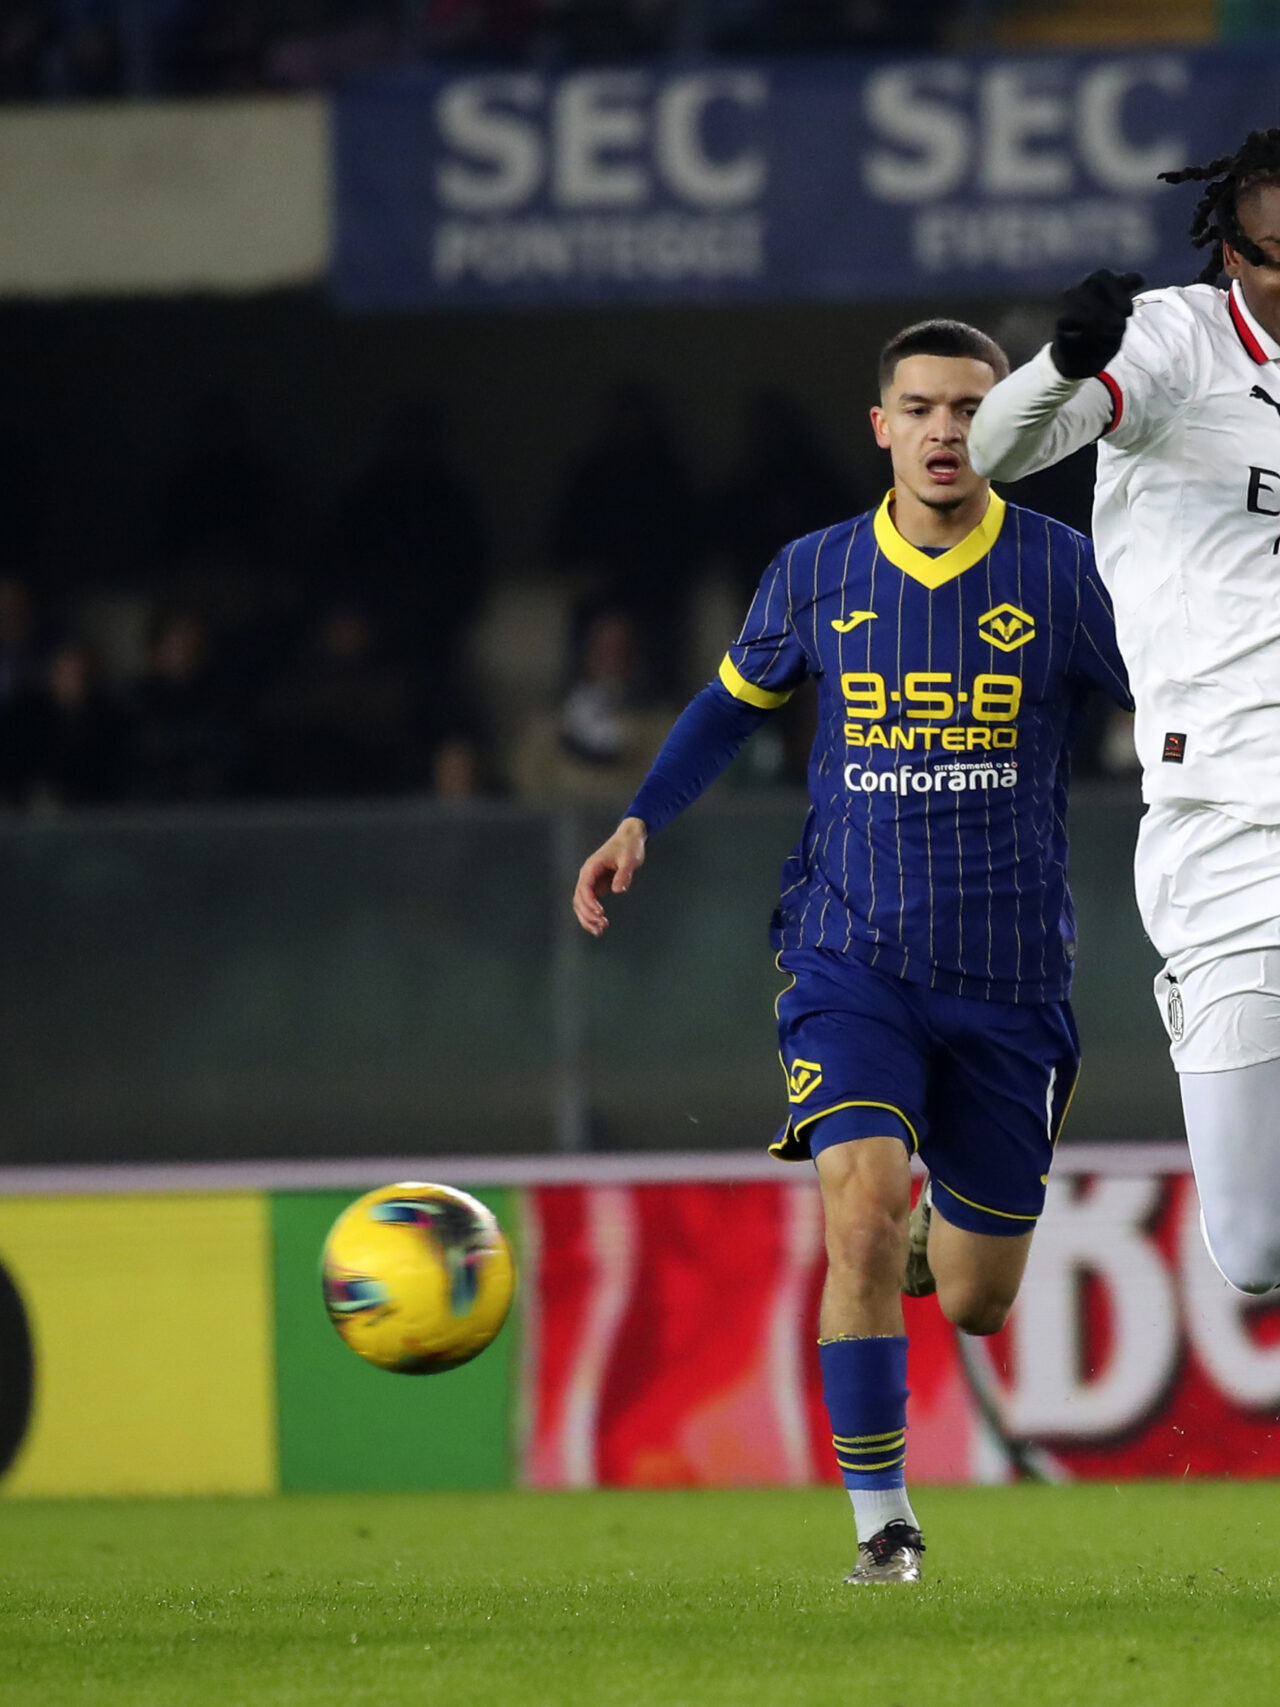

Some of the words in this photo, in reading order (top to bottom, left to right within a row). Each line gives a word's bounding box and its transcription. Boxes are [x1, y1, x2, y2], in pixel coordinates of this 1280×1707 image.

[434, 71, 768, 212] SEC
[863, 60, 1188, 202] SEC
[434, 216, 766, 284] PONTEGGI
[914, 204, 1157, 268] EVENTS
[844, 723, 1018, 750] SANTERO
[934, 762, 994, 771] arredamenti
[844, 763, 1018, 796] Conforama
